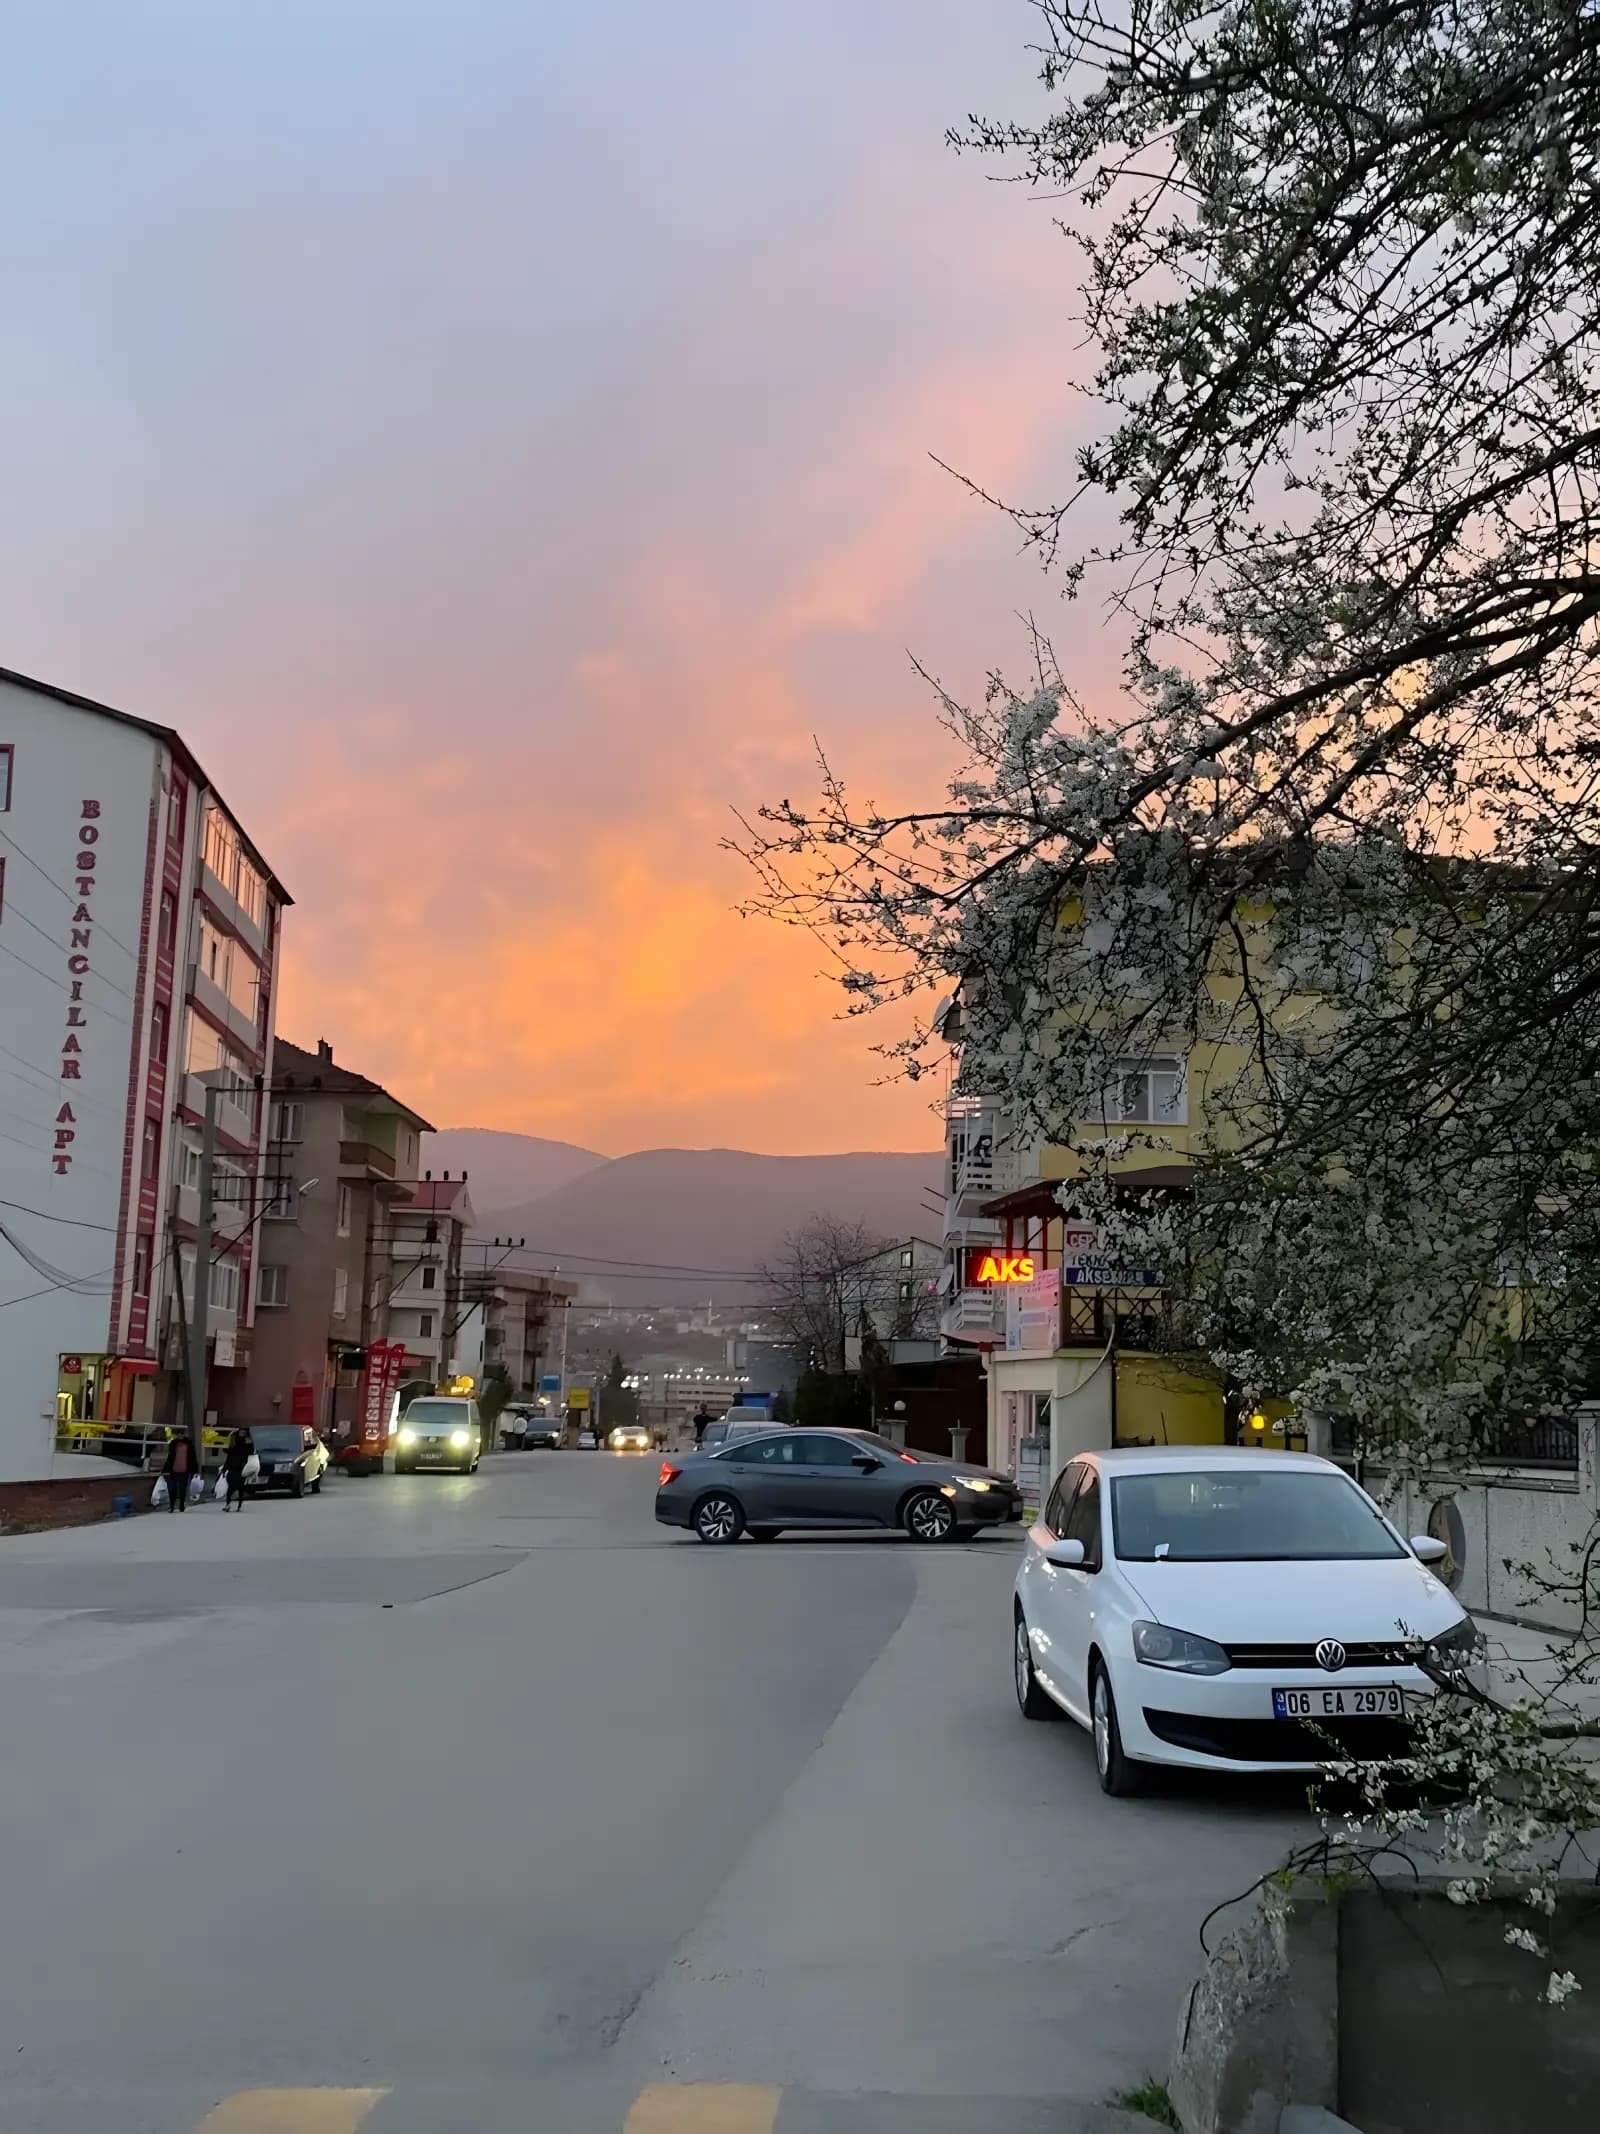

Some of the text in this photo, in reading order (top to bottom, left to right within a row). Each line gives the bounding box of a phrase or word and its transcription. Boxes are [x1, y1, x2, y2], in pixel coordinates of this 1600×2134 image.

[52, 800, 100, 1174] BOSTANCILAR APT
[977, 1256, 1033, 1281] AKS
[1287, 1693, 1310, 1714] 06
[1323, 1692, 1345, 1713] EA
[1354, 1690, 1399, 1712] 2979
